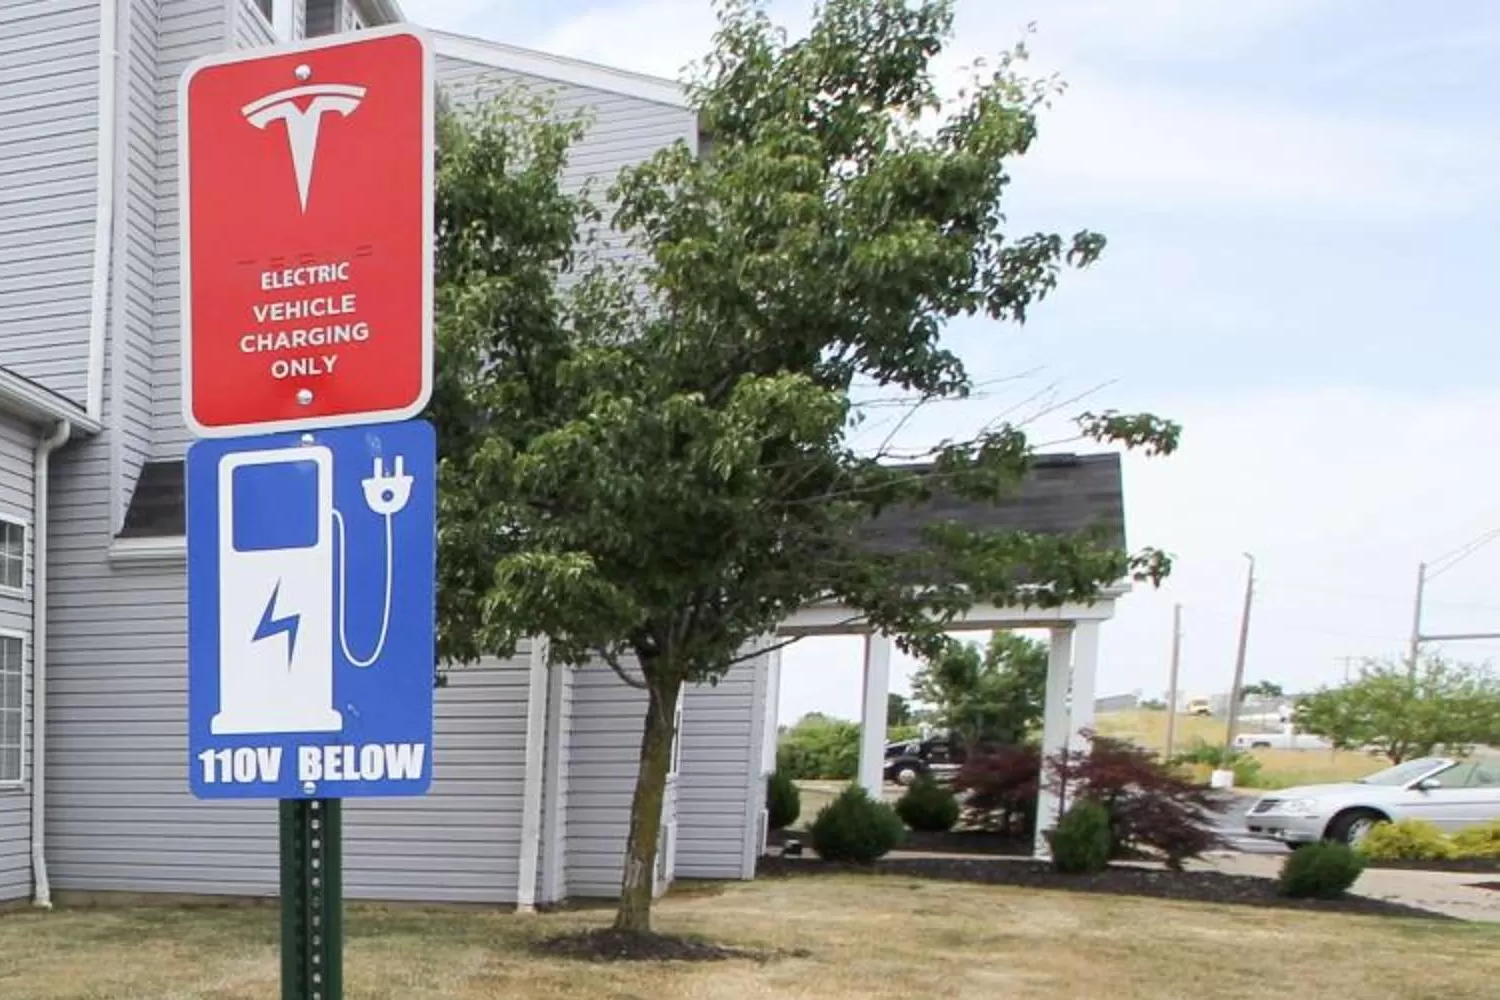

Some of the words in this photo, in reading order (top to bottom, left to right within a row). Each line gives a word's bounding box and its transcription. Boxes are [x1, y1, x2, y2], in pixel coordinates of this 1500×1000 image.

[261, 262, 349, 289] ELECTRIC
[253, 295, 356, 322] VEHICLE
[240, 323, 369, 352] CHARGING
[271, 355, 338, 379] ONLY
[198, 747, 283, 782] 110V
[299, 744, 425, 781] BELOW
